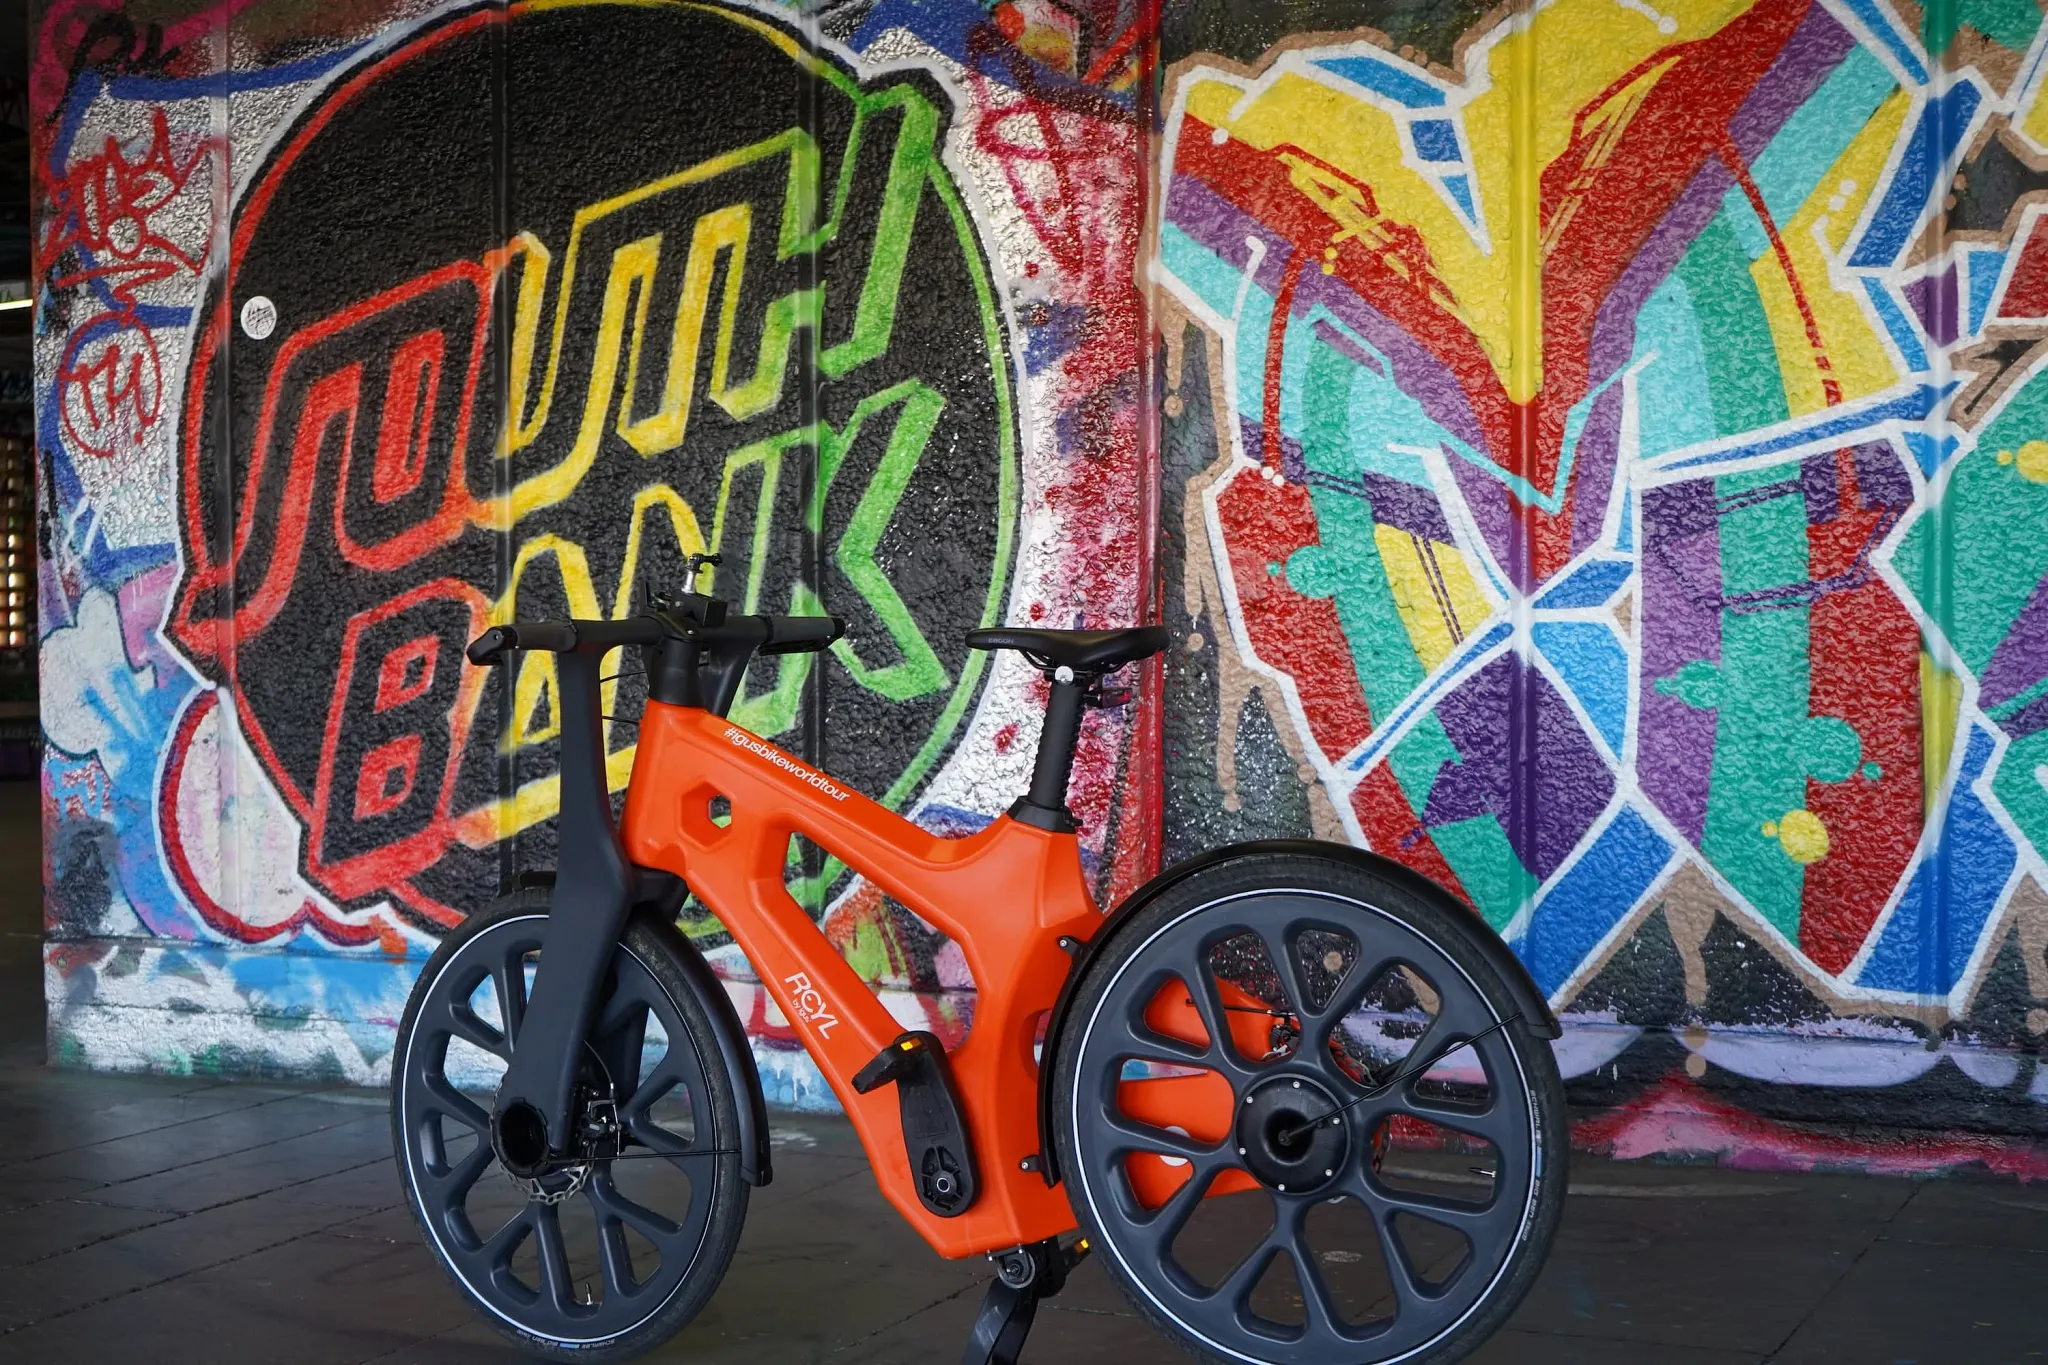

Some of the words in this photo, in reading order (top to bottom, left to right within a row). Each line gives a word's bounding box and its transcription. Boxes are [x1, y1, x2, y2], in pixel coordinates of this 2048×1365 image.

[988, 637, 1015, 645] ERGON
[723, 726, 852, 802] #igusbikeworldtour
[784, 971, 839, 1040] RCYL
